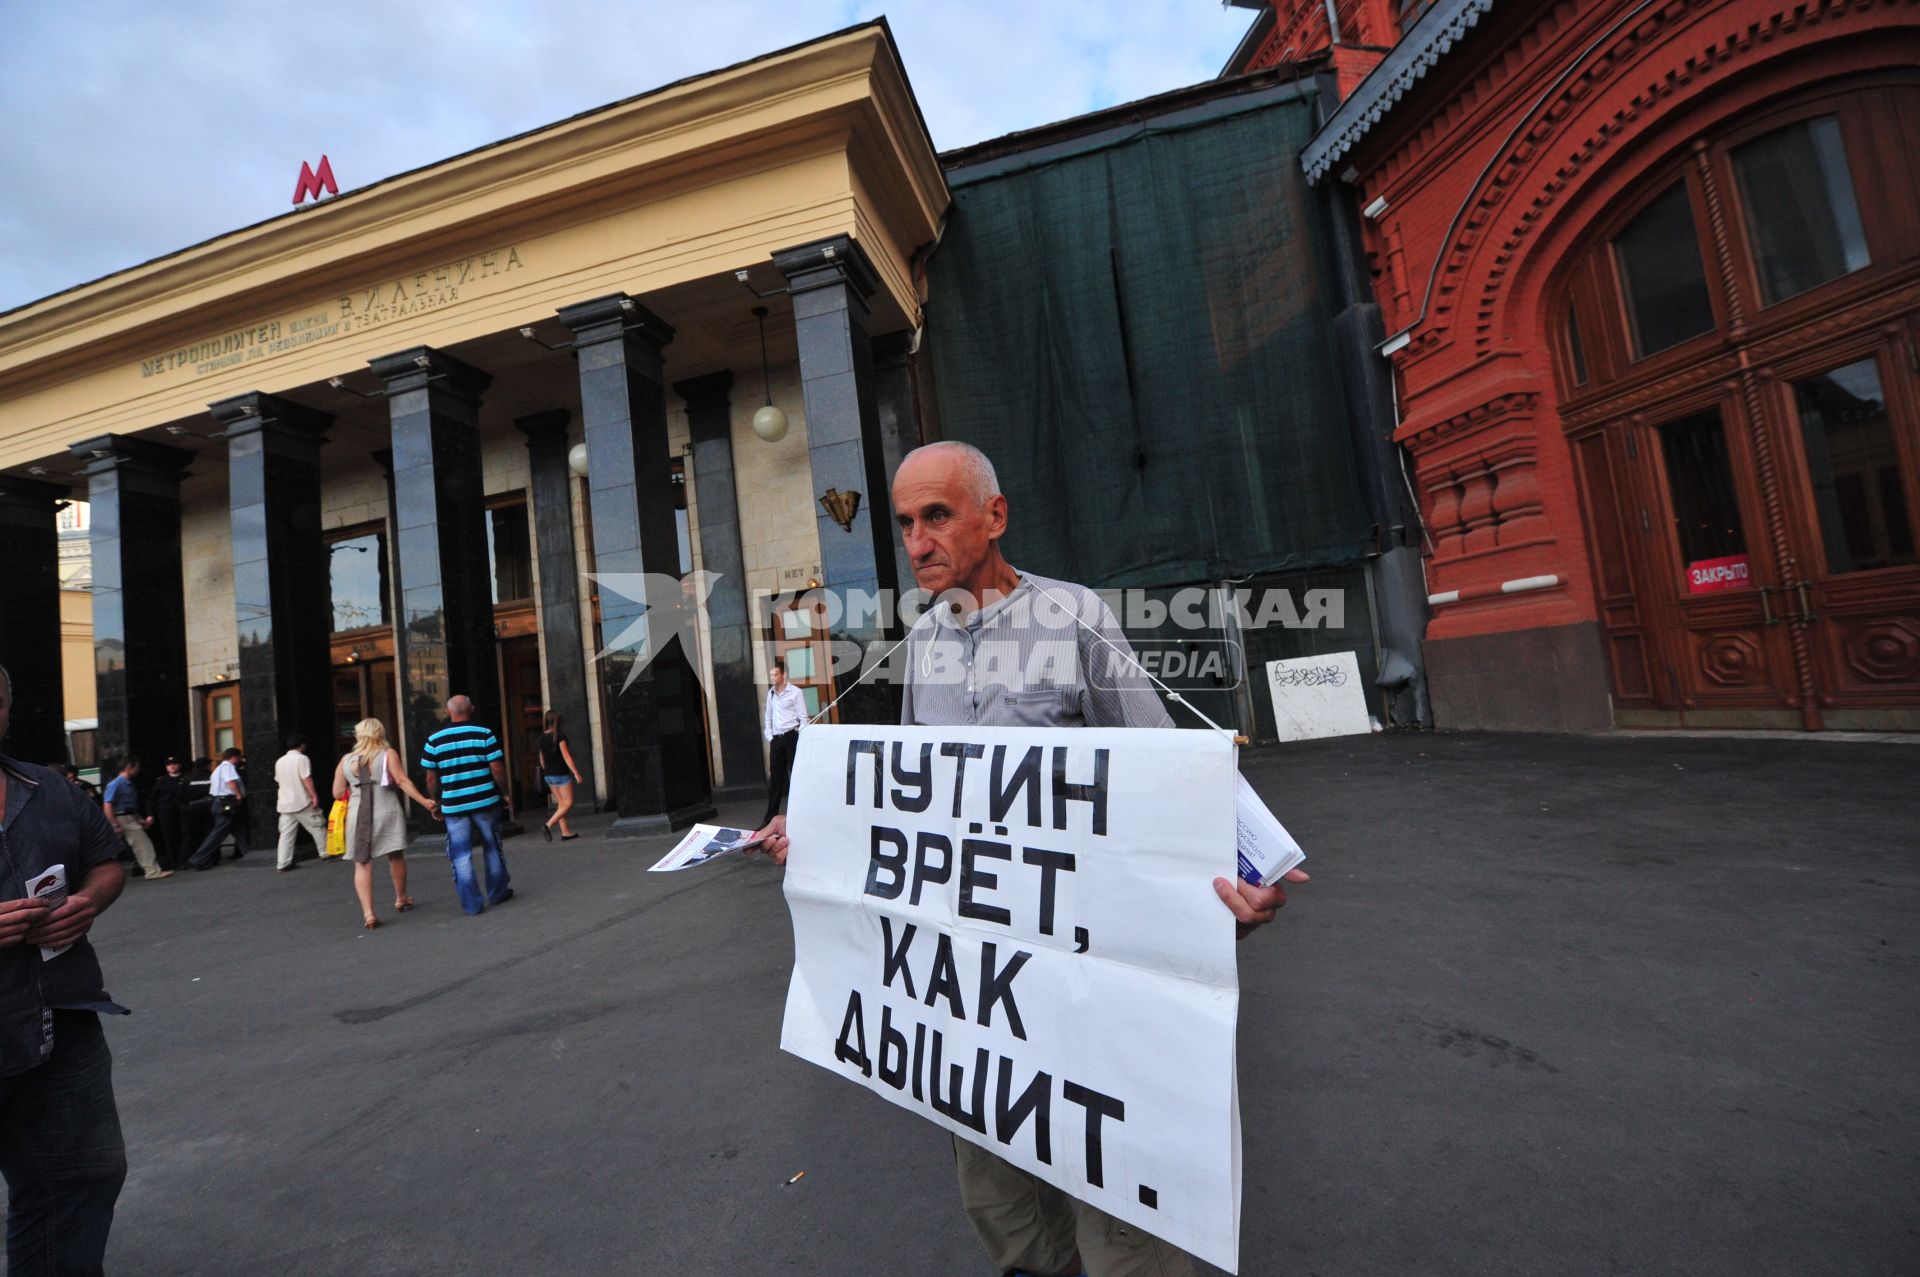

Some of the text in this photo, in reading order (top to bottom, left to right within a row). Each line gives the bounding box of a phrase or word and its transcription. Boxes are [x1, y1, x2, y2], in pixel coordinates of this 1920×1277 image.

[354, 287, 459, 328] ТЕАТРАЛЬНАЯ
[140, 320, 282, 378] МЕТРОПОЛИТЕН
[784, 568, 805, 579] НЕТ
[1692, 562, 1748, 585] ЗАКРЫТО
[846, 739, 1110, 836] ПУТИН
[864, 822, 1090, 954] ВРЁТ,
[879, 915, 1033, 1042] КАК
[834, 989, 1158, 1210] ДЫШИТ.
